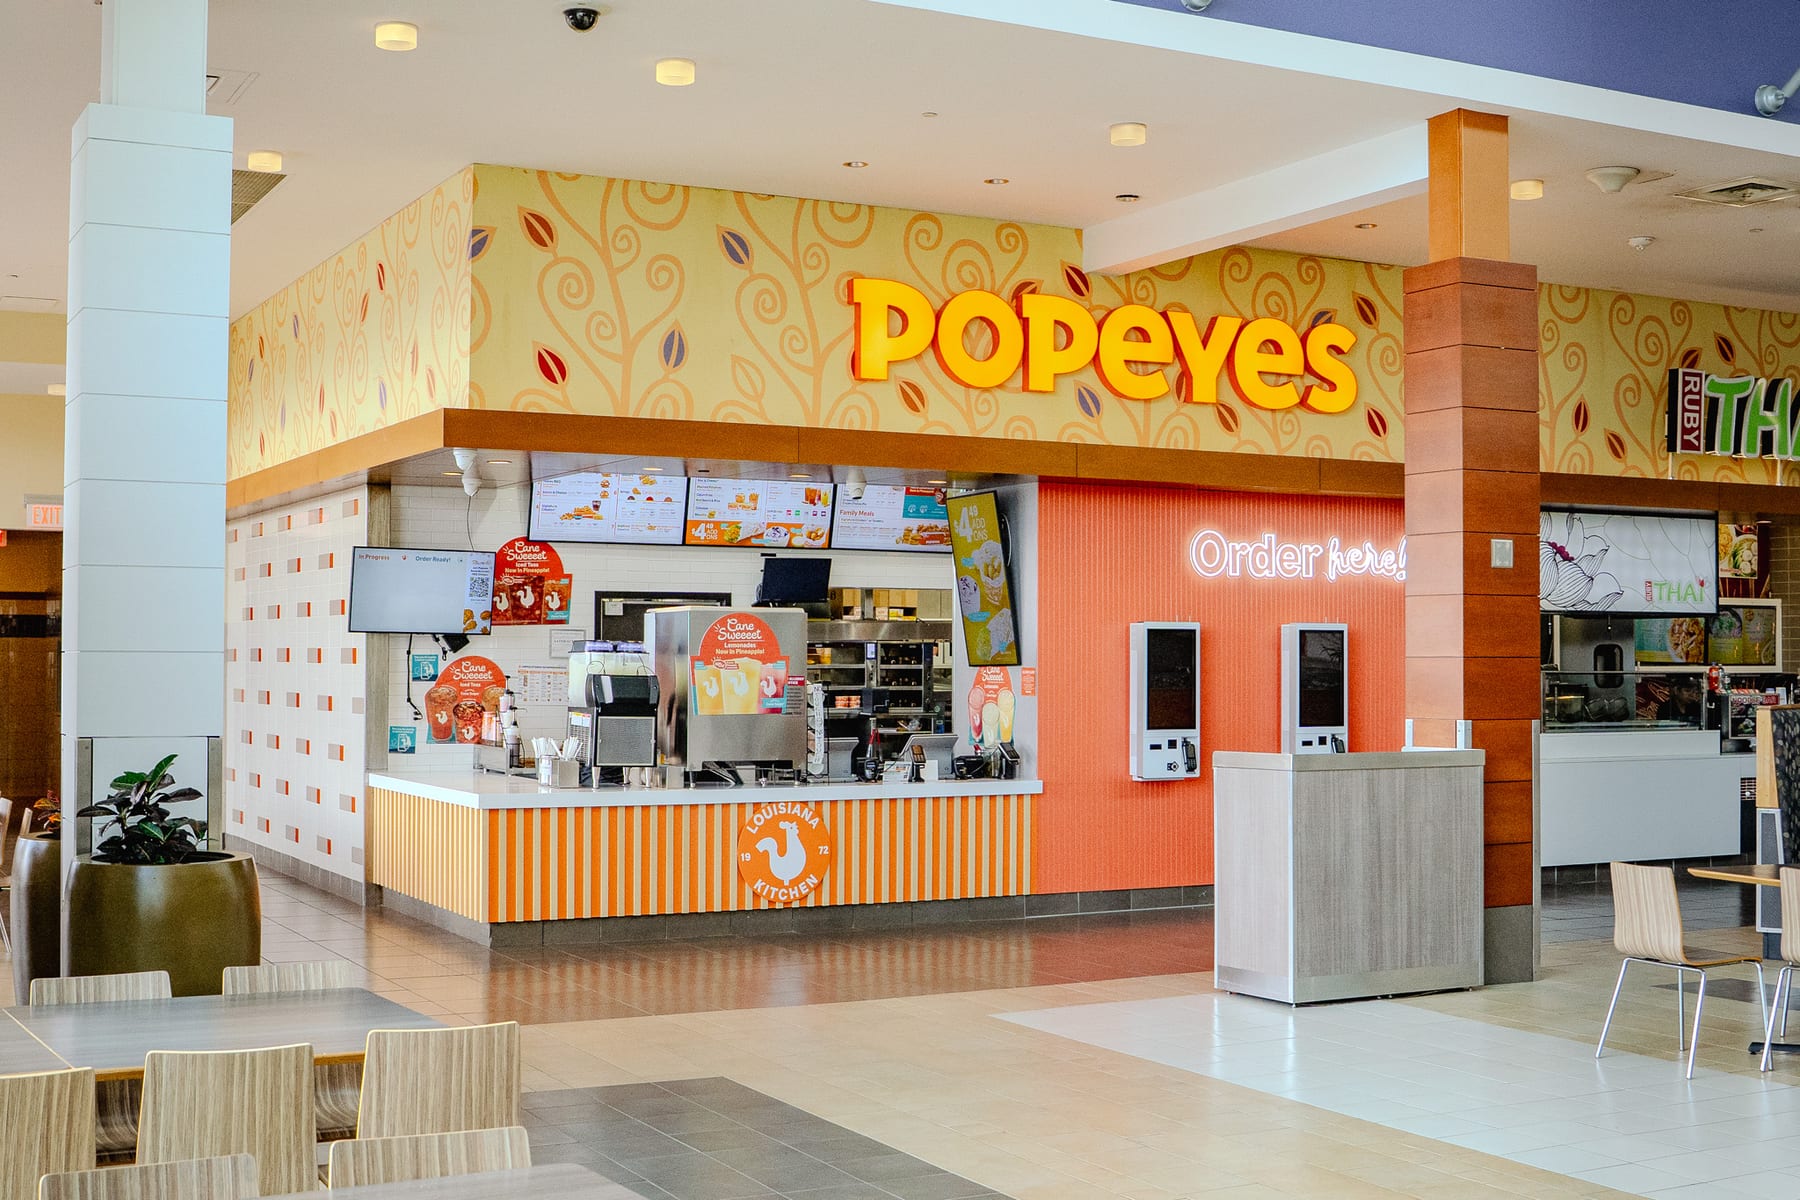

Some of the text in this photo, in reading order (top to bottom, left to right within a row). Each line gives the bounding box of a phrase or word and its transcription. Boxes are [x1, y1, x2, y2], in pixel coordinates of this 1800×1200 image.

[1683, 375, 1700, 447] RUBY
[1704, 374, 1800, 461] TH
[32, 505, 62, 525] EXIT
[515, 541, 540, 553] Cane
[1190, 529, 1323, 578] Order
[727, 618, 754, 631] Cane
[462, 661, 486, 672] Cane
[746, 802, 820, 834] LOUISIANA
[741, 846, 829, 862] 19 72
[753, 874, 819, 900] KITCHEN
